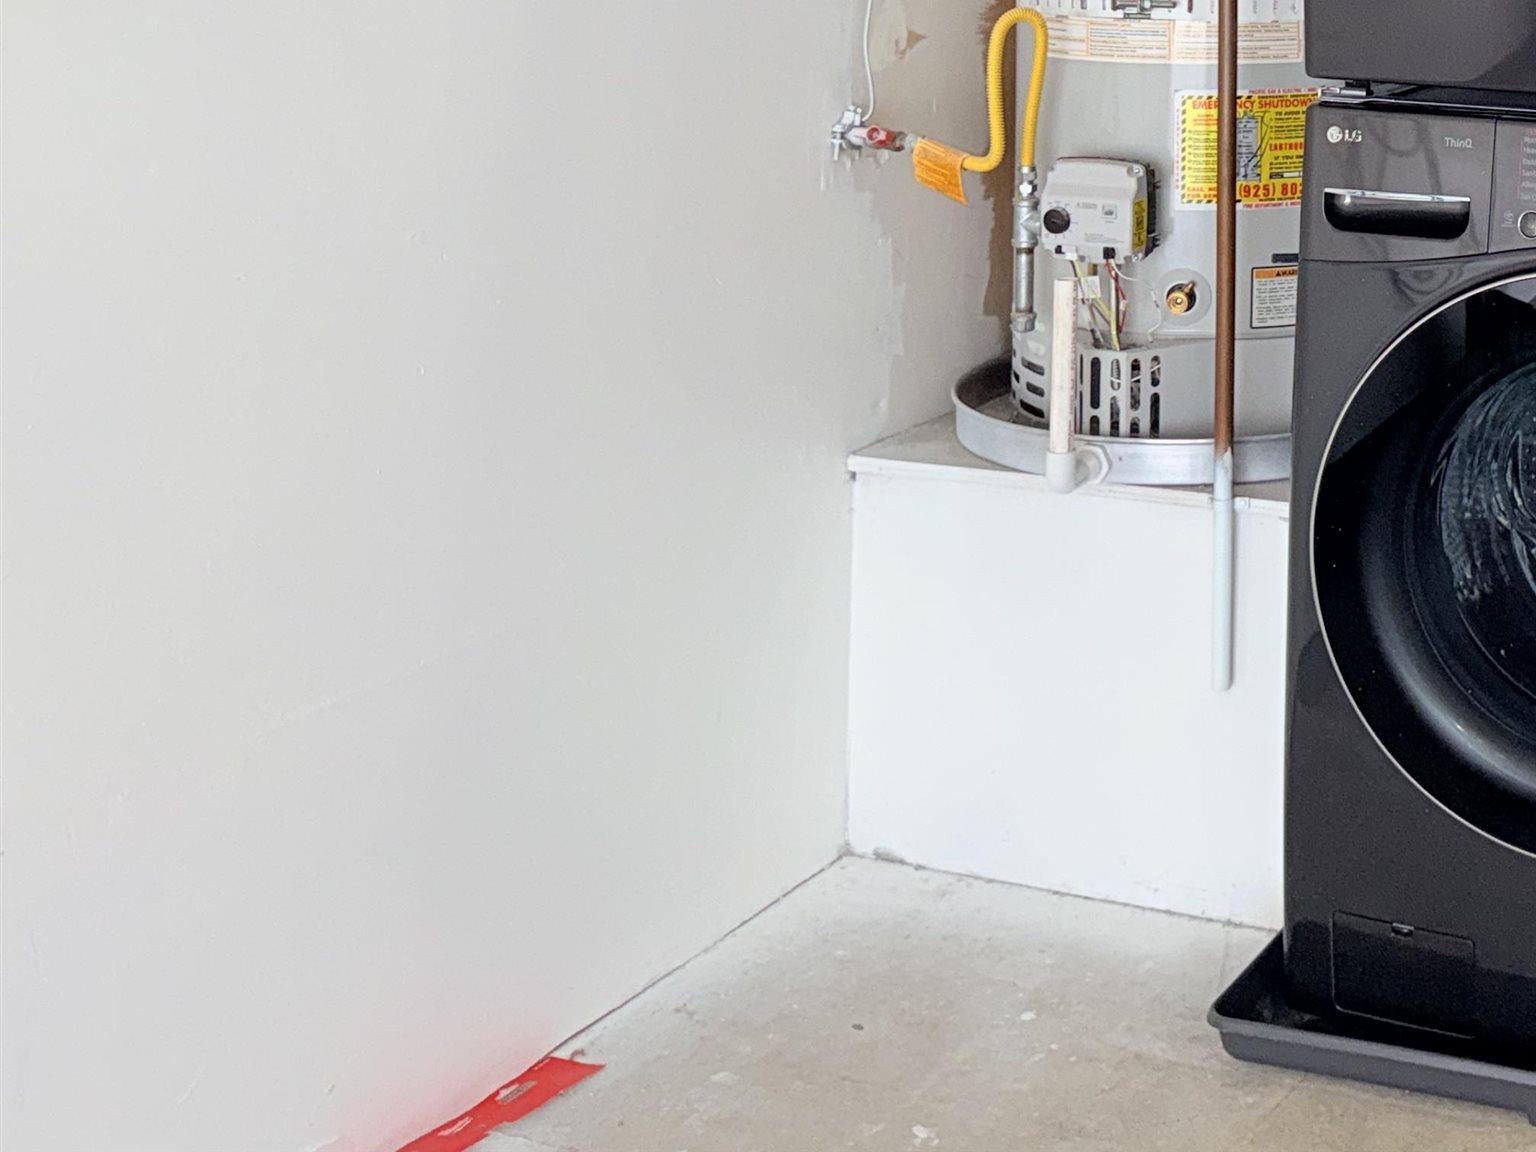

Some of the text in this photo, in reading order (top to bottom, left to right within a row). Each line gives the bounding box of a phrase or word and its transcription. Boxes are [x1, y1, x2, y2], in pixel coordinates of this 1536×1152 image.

[1344, 130, 1363, 142] LG
[1444, 136, 1473, 149] ThinQ
[1238, 182, 1276, 199] (925)
